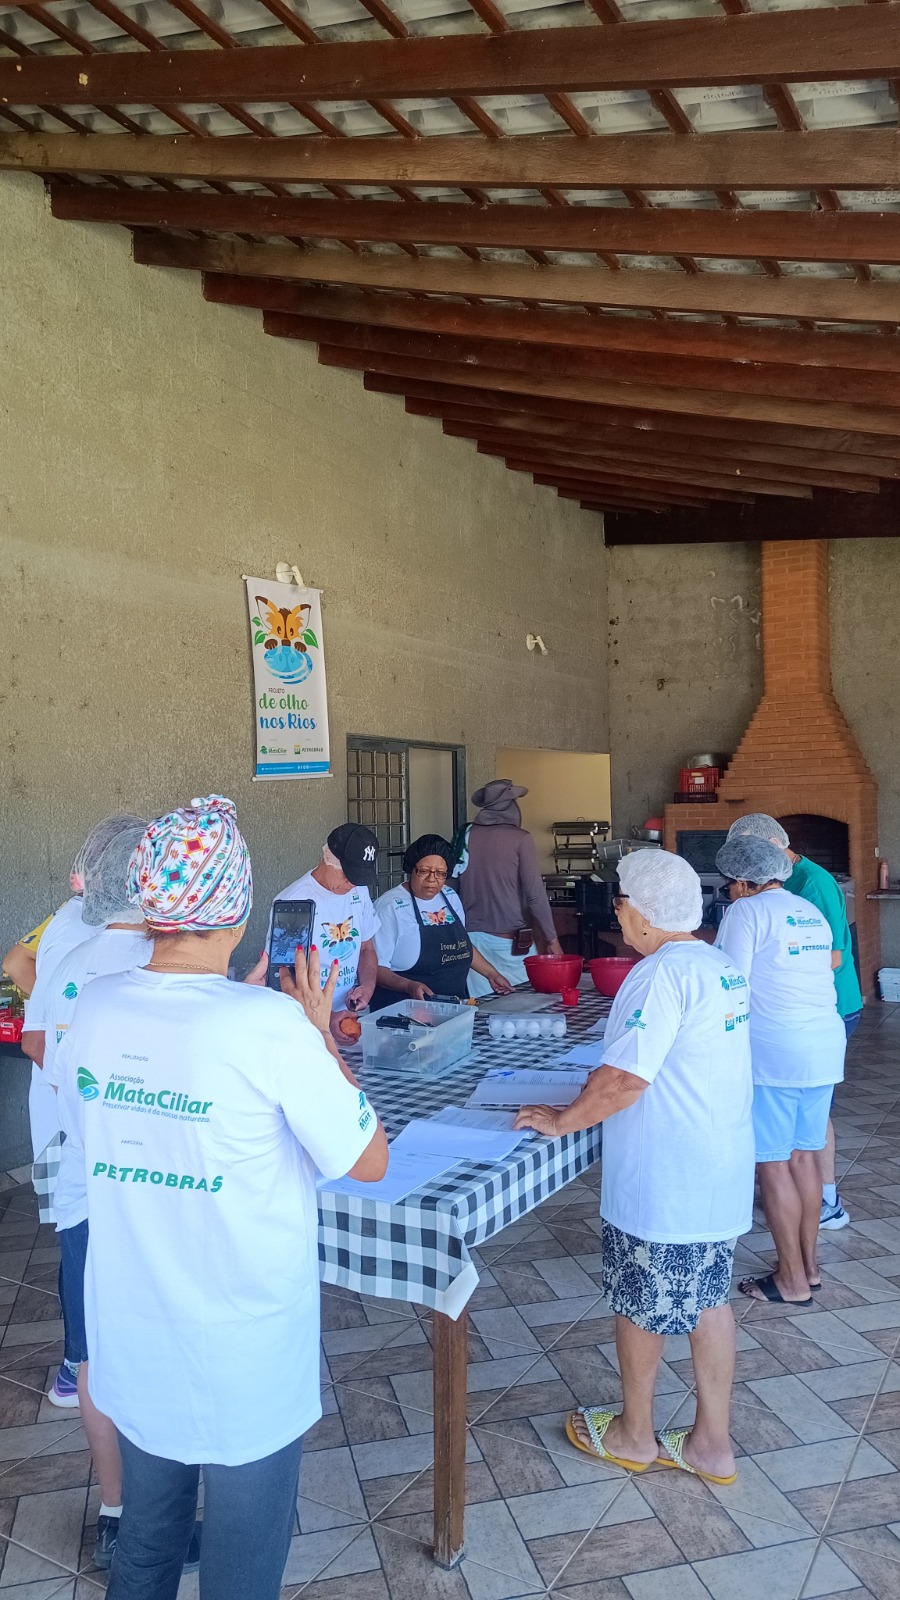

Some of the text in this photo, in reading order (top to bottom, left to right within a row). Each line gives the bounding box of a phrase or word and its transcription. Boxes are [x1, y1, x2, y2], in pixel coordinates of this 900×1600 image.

[259, 693, 309, 710] de olho
[259, 712, 317, 730] nos Rios
[338, 965, 355, 977] olho
[109, 1073, 145, 1085] Associação
[103, 1081, 213, 1115] MataCiliar
[102, 1101, 130, 1112] Preservar
[130, 1104, 147, 1114] vidas
[152, 1107, 161, 1116] da
[161, 1111, 178, 1120] nossa
[92, 1162, 224, 1193] PETROBRAS
